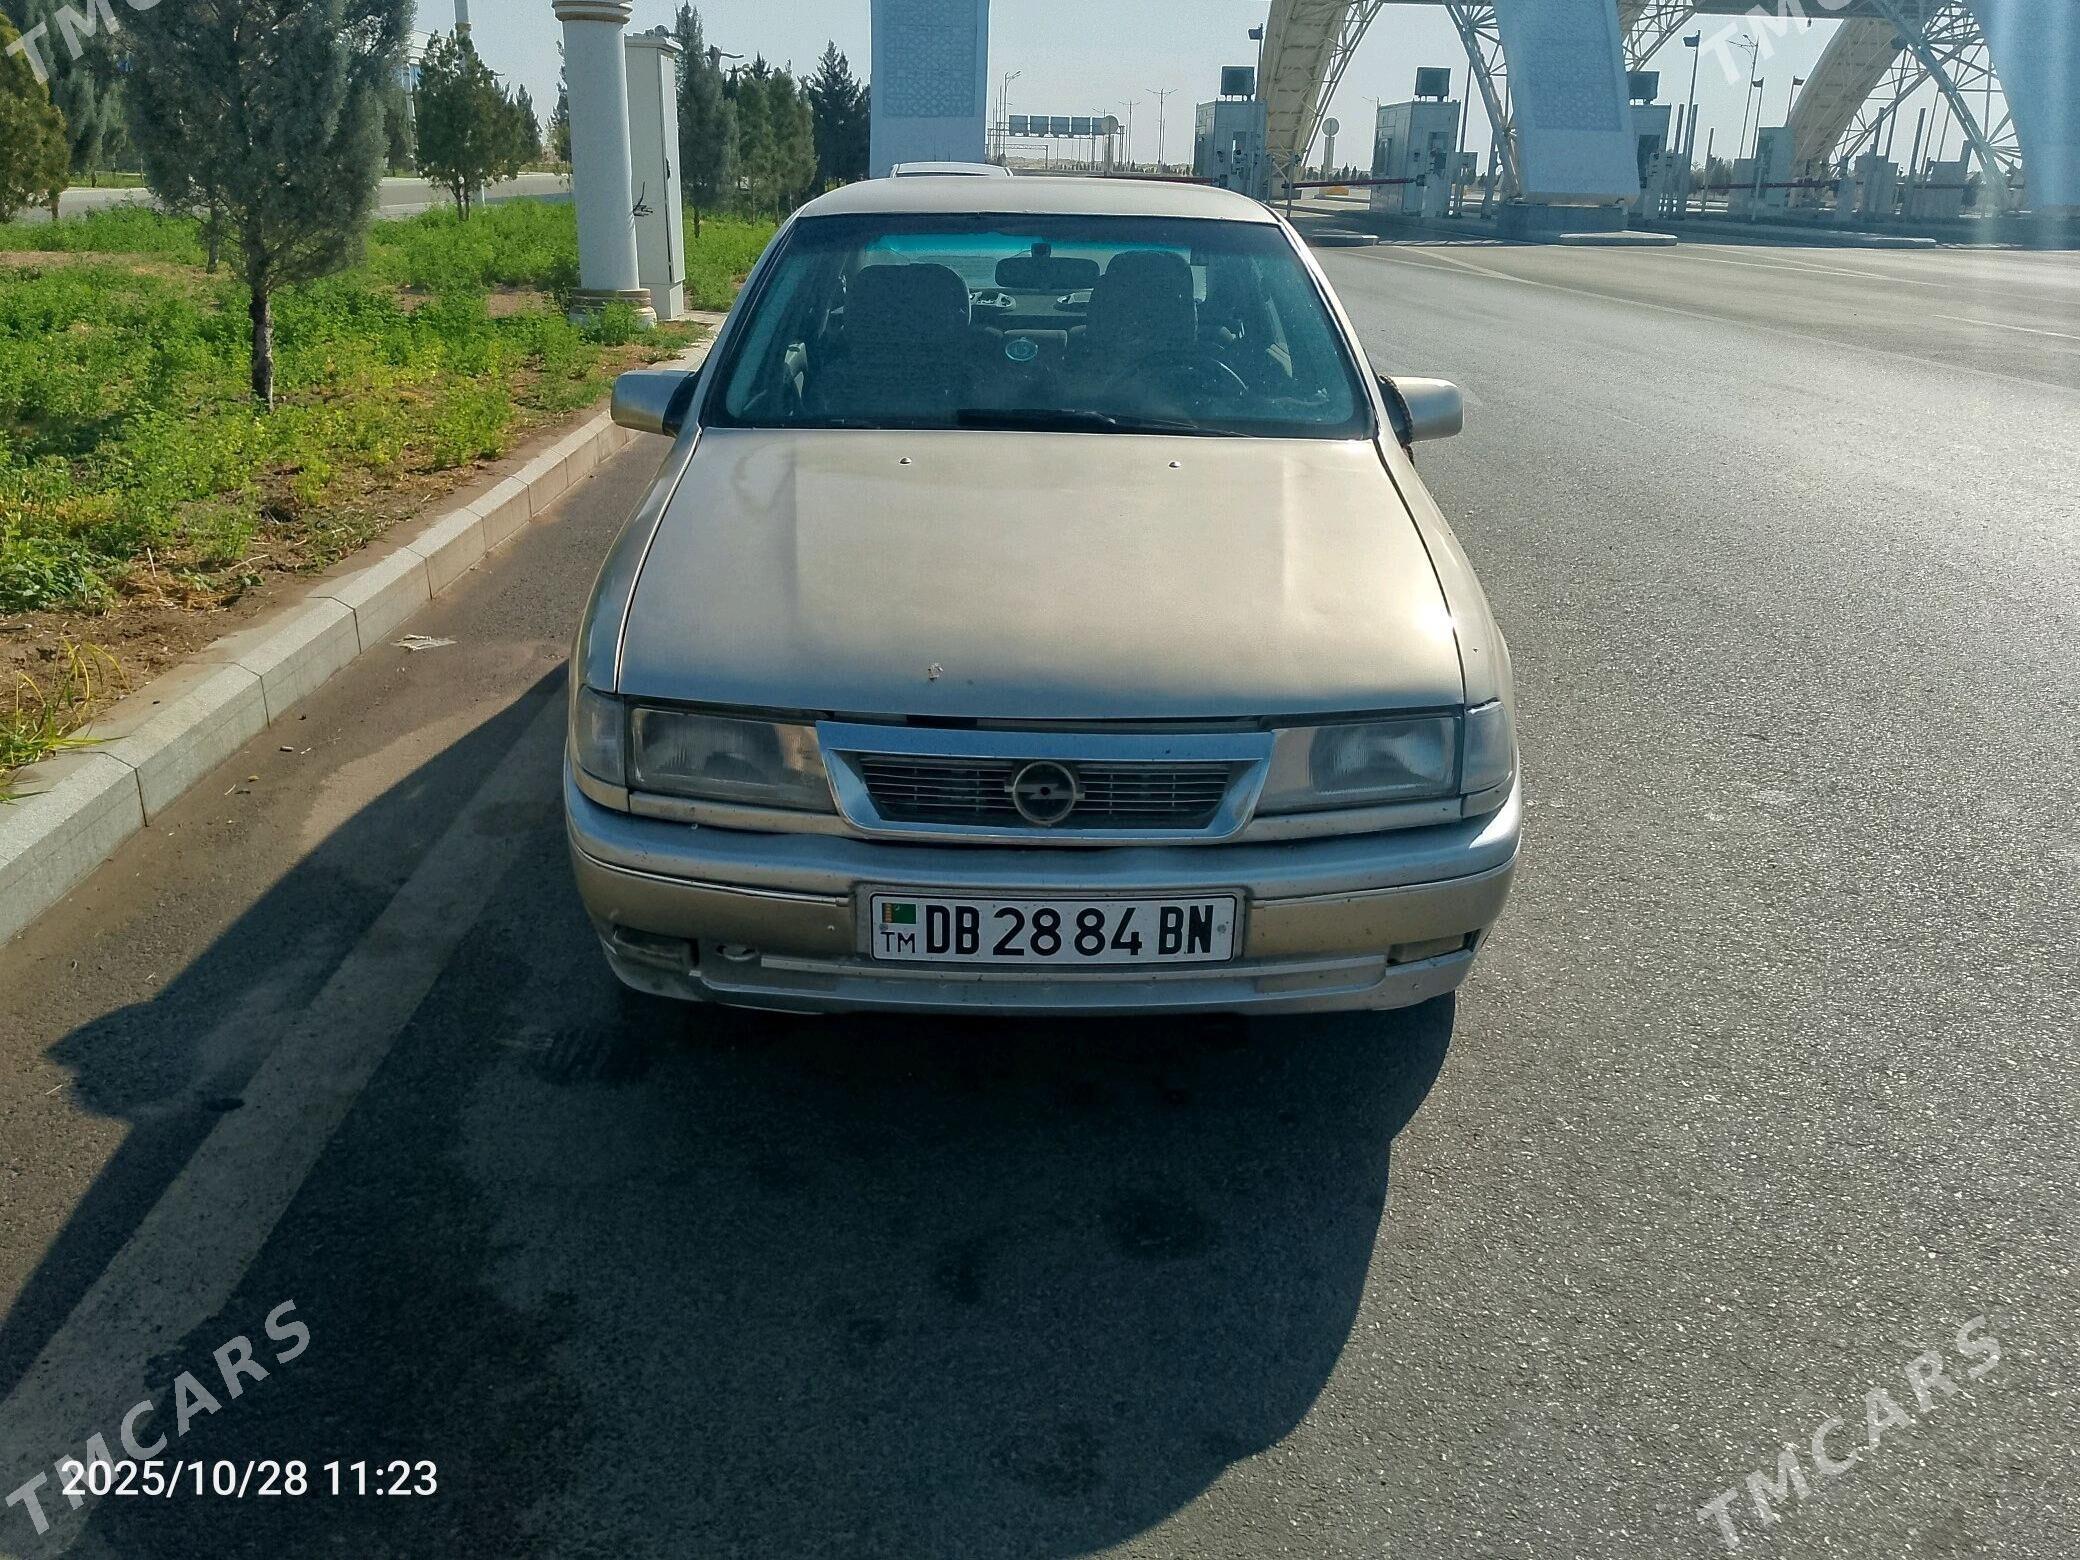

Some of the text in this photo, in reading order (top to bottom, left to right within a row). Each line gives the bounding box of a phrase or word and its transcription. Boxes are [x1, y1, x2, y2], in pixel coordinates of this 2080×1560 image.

[880, 931, 916, 954] TM
[925, 905, 980, 955] DB
[1158, 904, 1213, 955] BN
